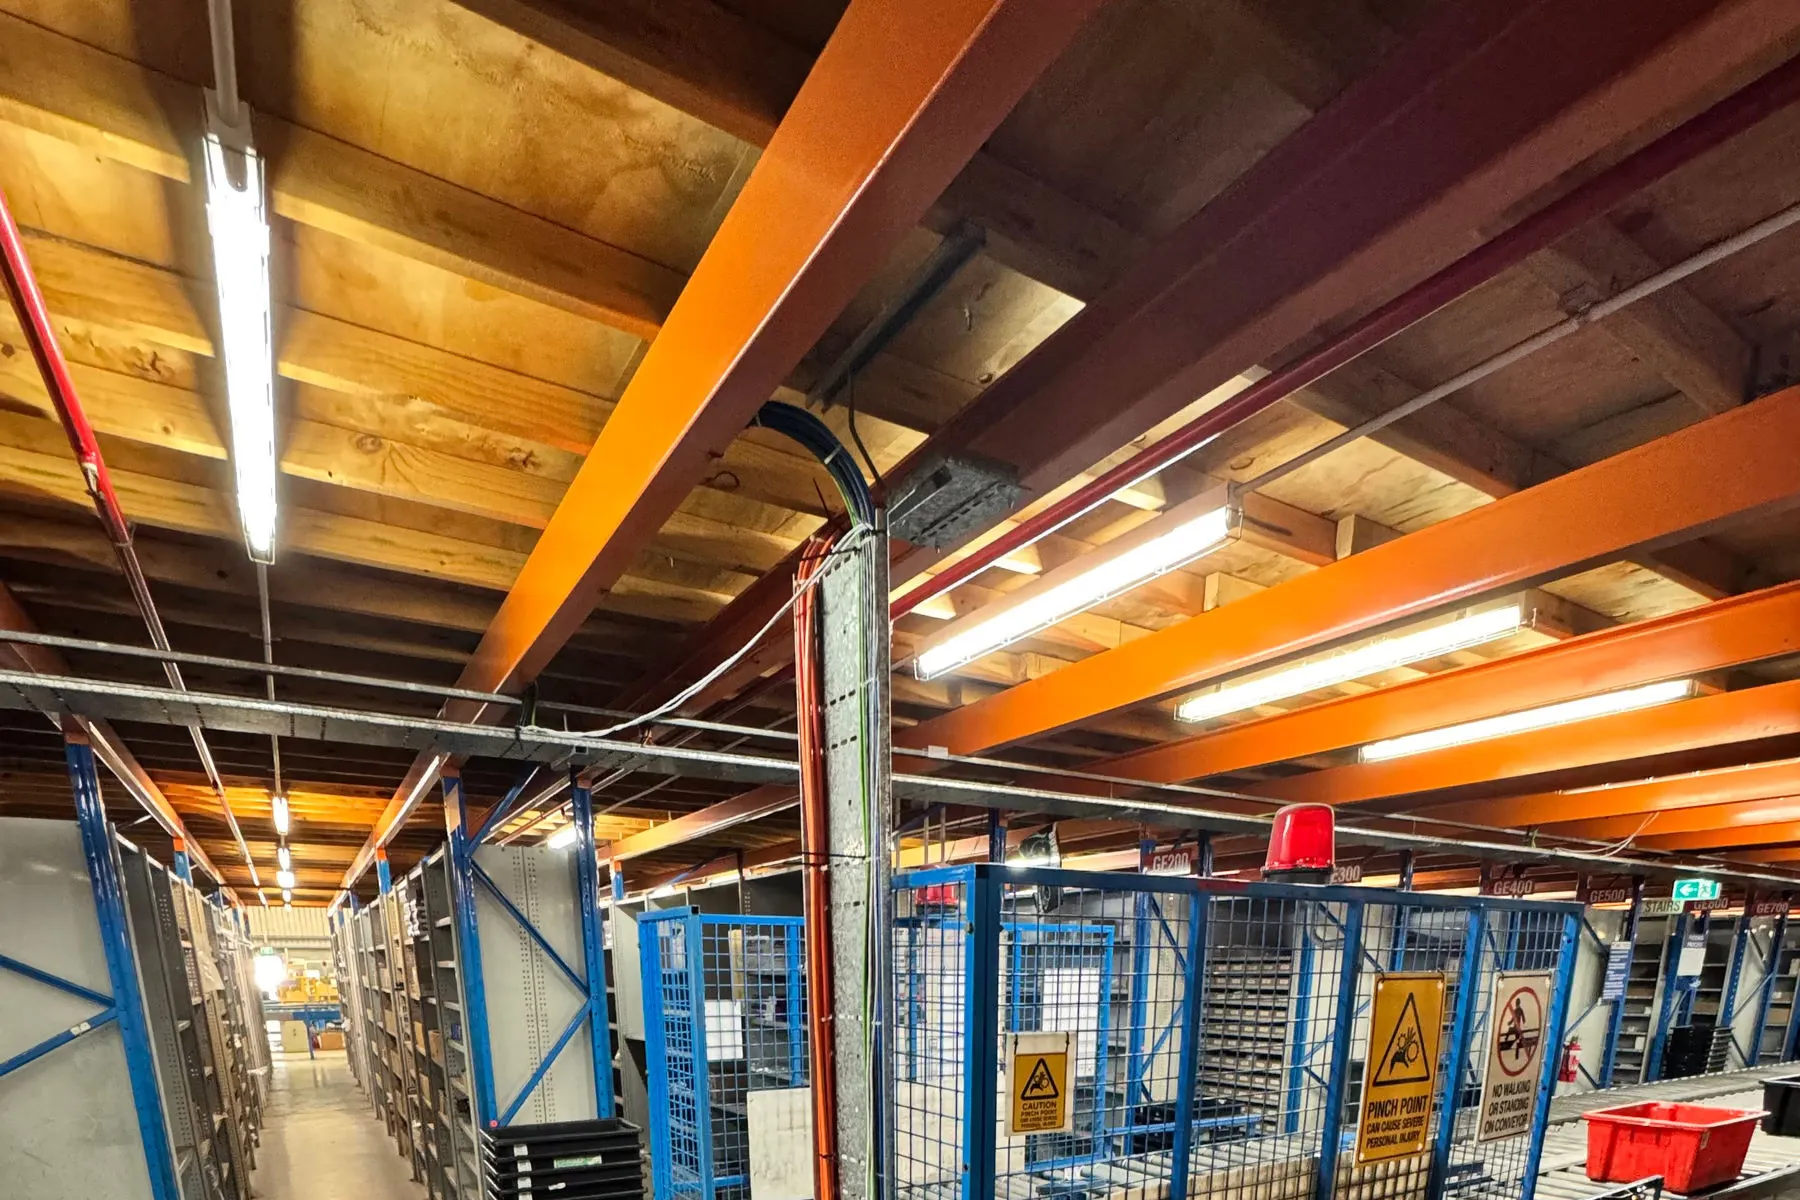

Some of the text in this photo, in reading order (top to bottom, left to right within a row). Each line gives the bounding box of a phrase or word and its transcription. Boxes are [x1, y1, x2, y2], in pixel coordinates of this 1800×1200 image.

[1152, 852, 1189, 872] GE200
[1493, 880, 1533, 895] GE400
[1590, 889, 1626, 903] GE500
[1644, 900, 1681, 913] STAIRS
[1757, 902, 1789, 914] GE700
[1492, 1080, 1531, 1098] NO WALKING
[1022, 1101, 1057, 1110] CAUTION
[1367, 1095, 1429, 1120] PINCH POINT
[1488, 1097, 1530, 1117] OR STANDING
[1366, 1115, 1425, 1134] CAN CAUSE SEVERE
[1484, 1114, 1528, 1134] ON CONVEYOR
[1366, 1130, 1421, 1149] PERSONAL INJURY
